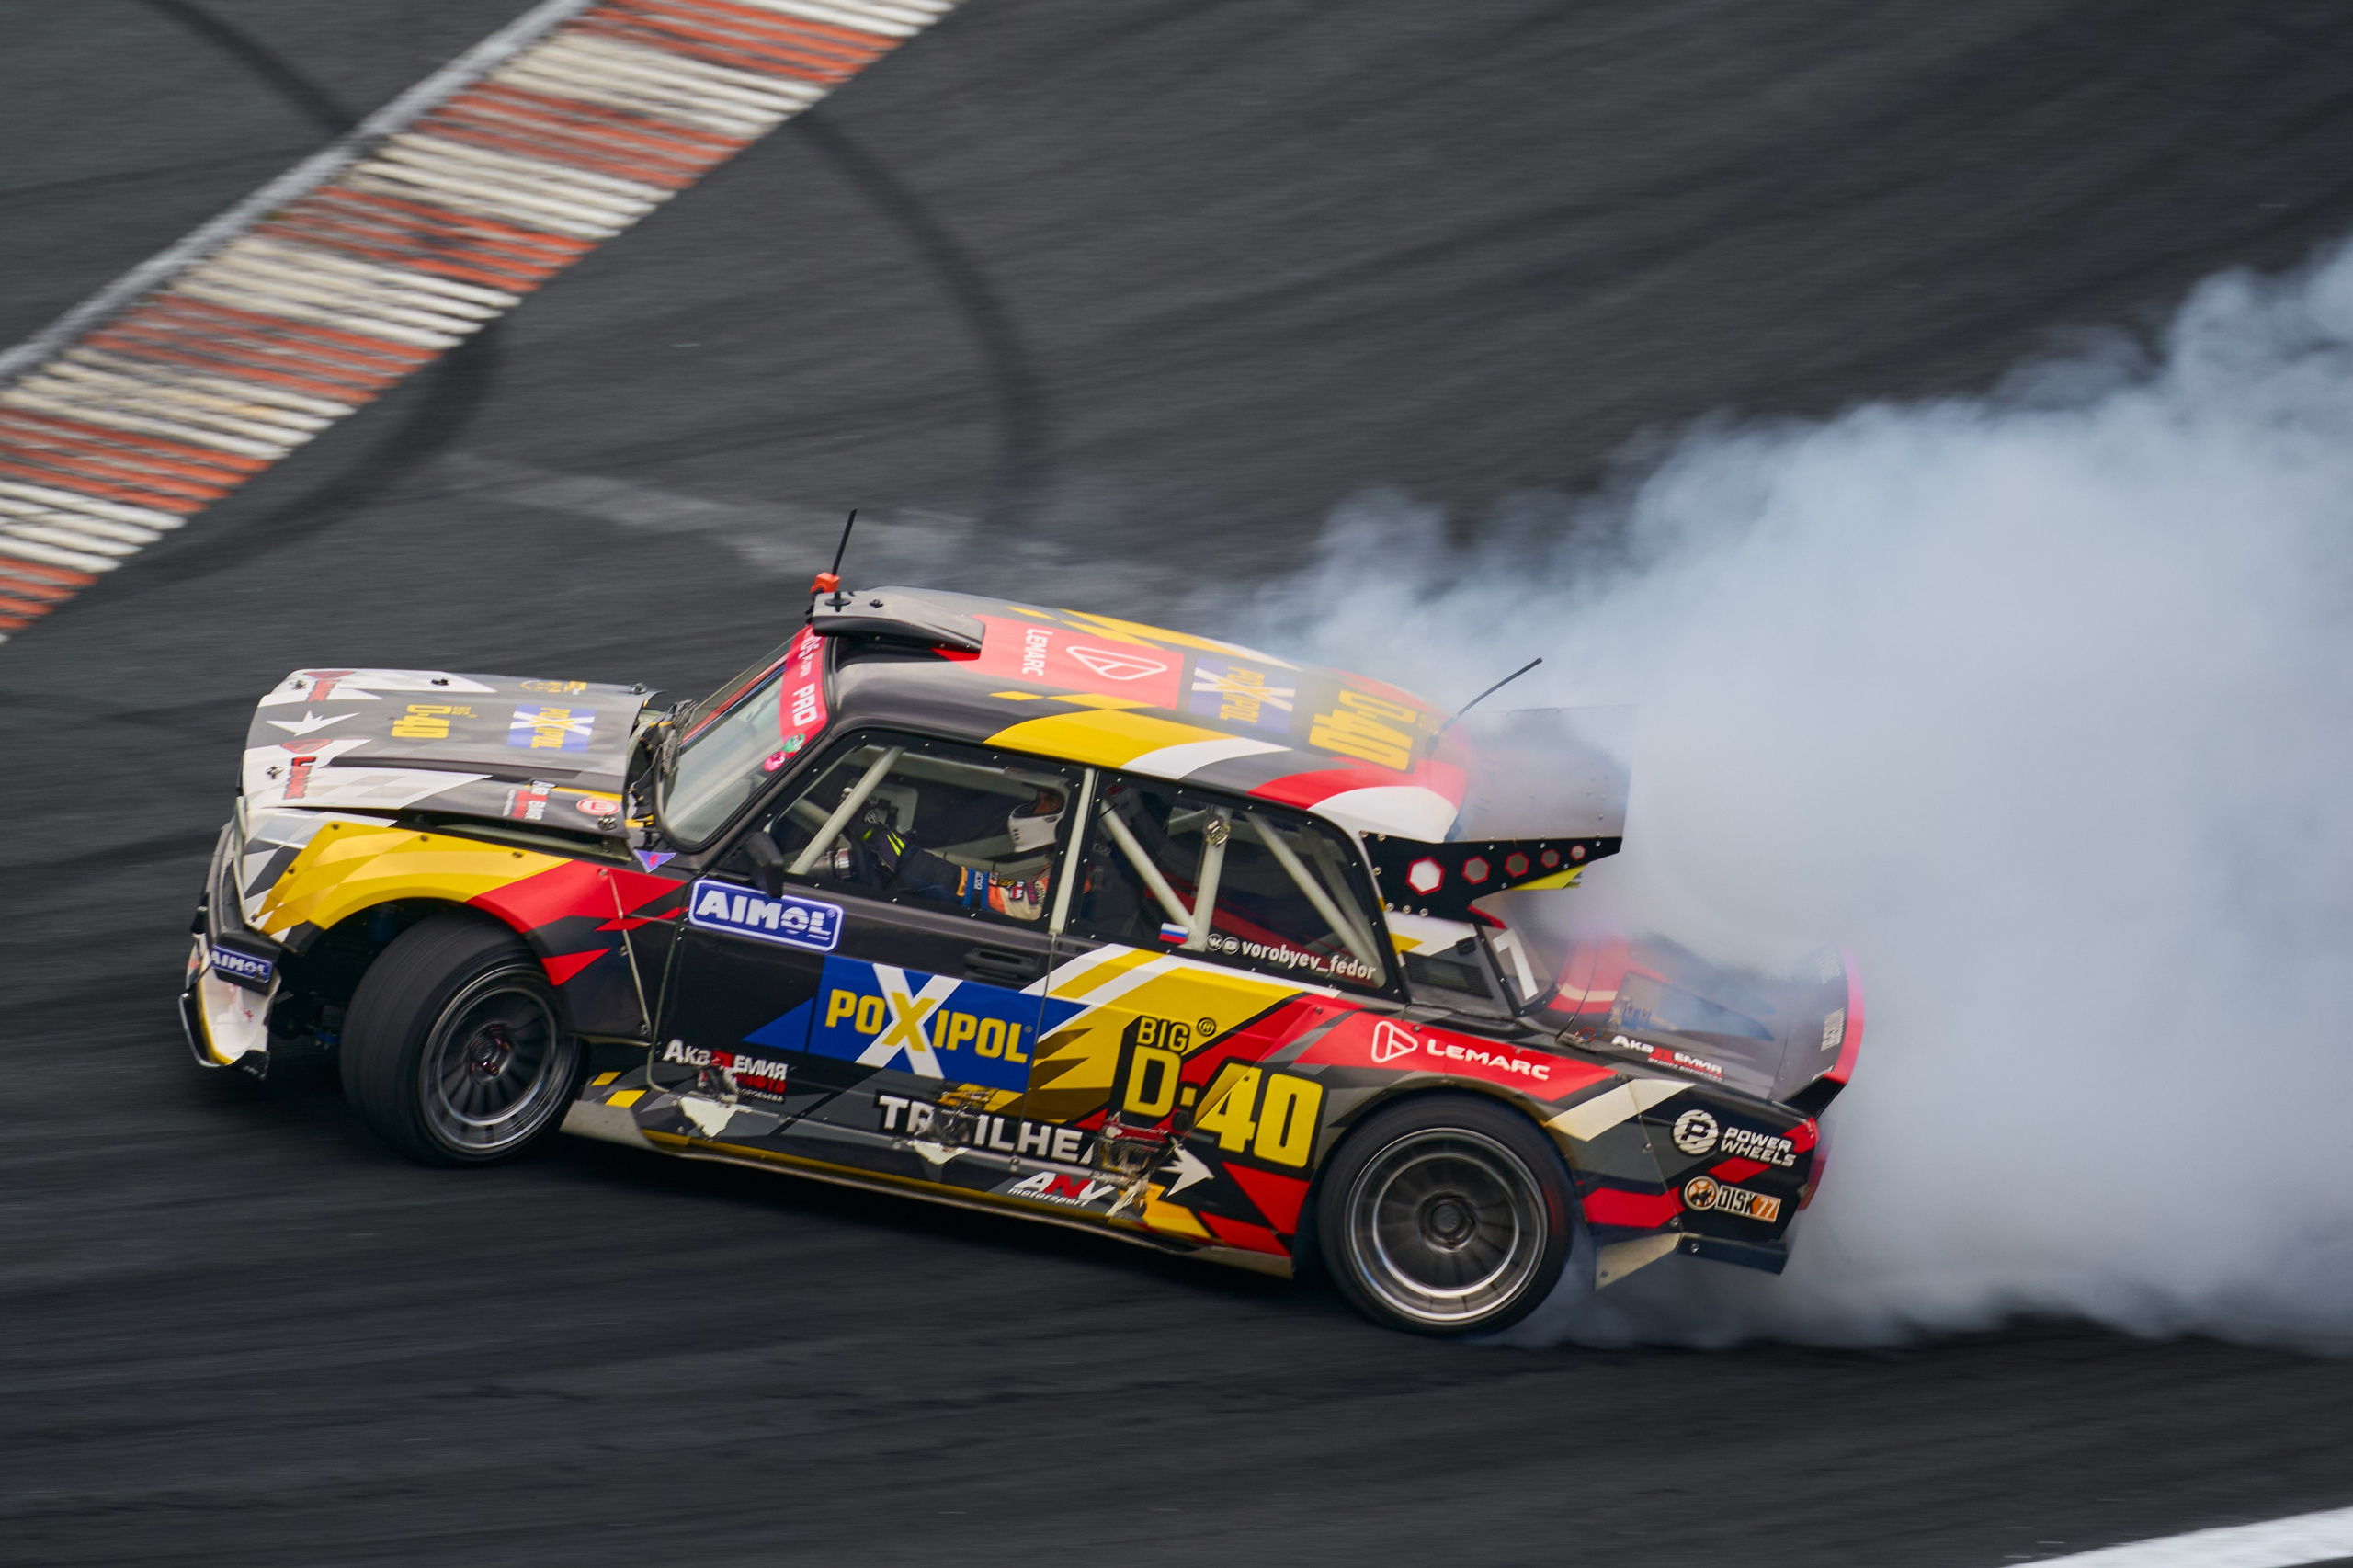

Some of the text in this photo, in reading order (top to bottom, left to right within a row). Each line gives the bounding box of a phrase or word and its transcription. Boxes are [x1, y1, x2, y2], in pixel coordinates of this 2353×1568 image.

[1022, 629, 1053, 676] LEMARC
[792, 683, 817, 726] PRO
[1216, 666, 1271, 724] POXIPOL
[391, 704, 452, 739] D-40
[530, 707, 574, 748] POXIPOL
[1309, 689, 1417, 771] D-40
[695, 890, 832, 941] AIMOL
[1241, 940, 1377, 981] vorobyev_fedor
[825, 988, 1029, 1064] POXIPOL
[1137, 1017, 1190, 1053] BIG
[1427, 1039, 1551, 1081] LEMARC
[1122, 1044, 1324, 1168] D-40
[1720, 1139, 1798, 1168] WHEELS
[1724, 1126, 1793, 1153] POWER
[1007, 1187, 1087, 1207] motorsport
